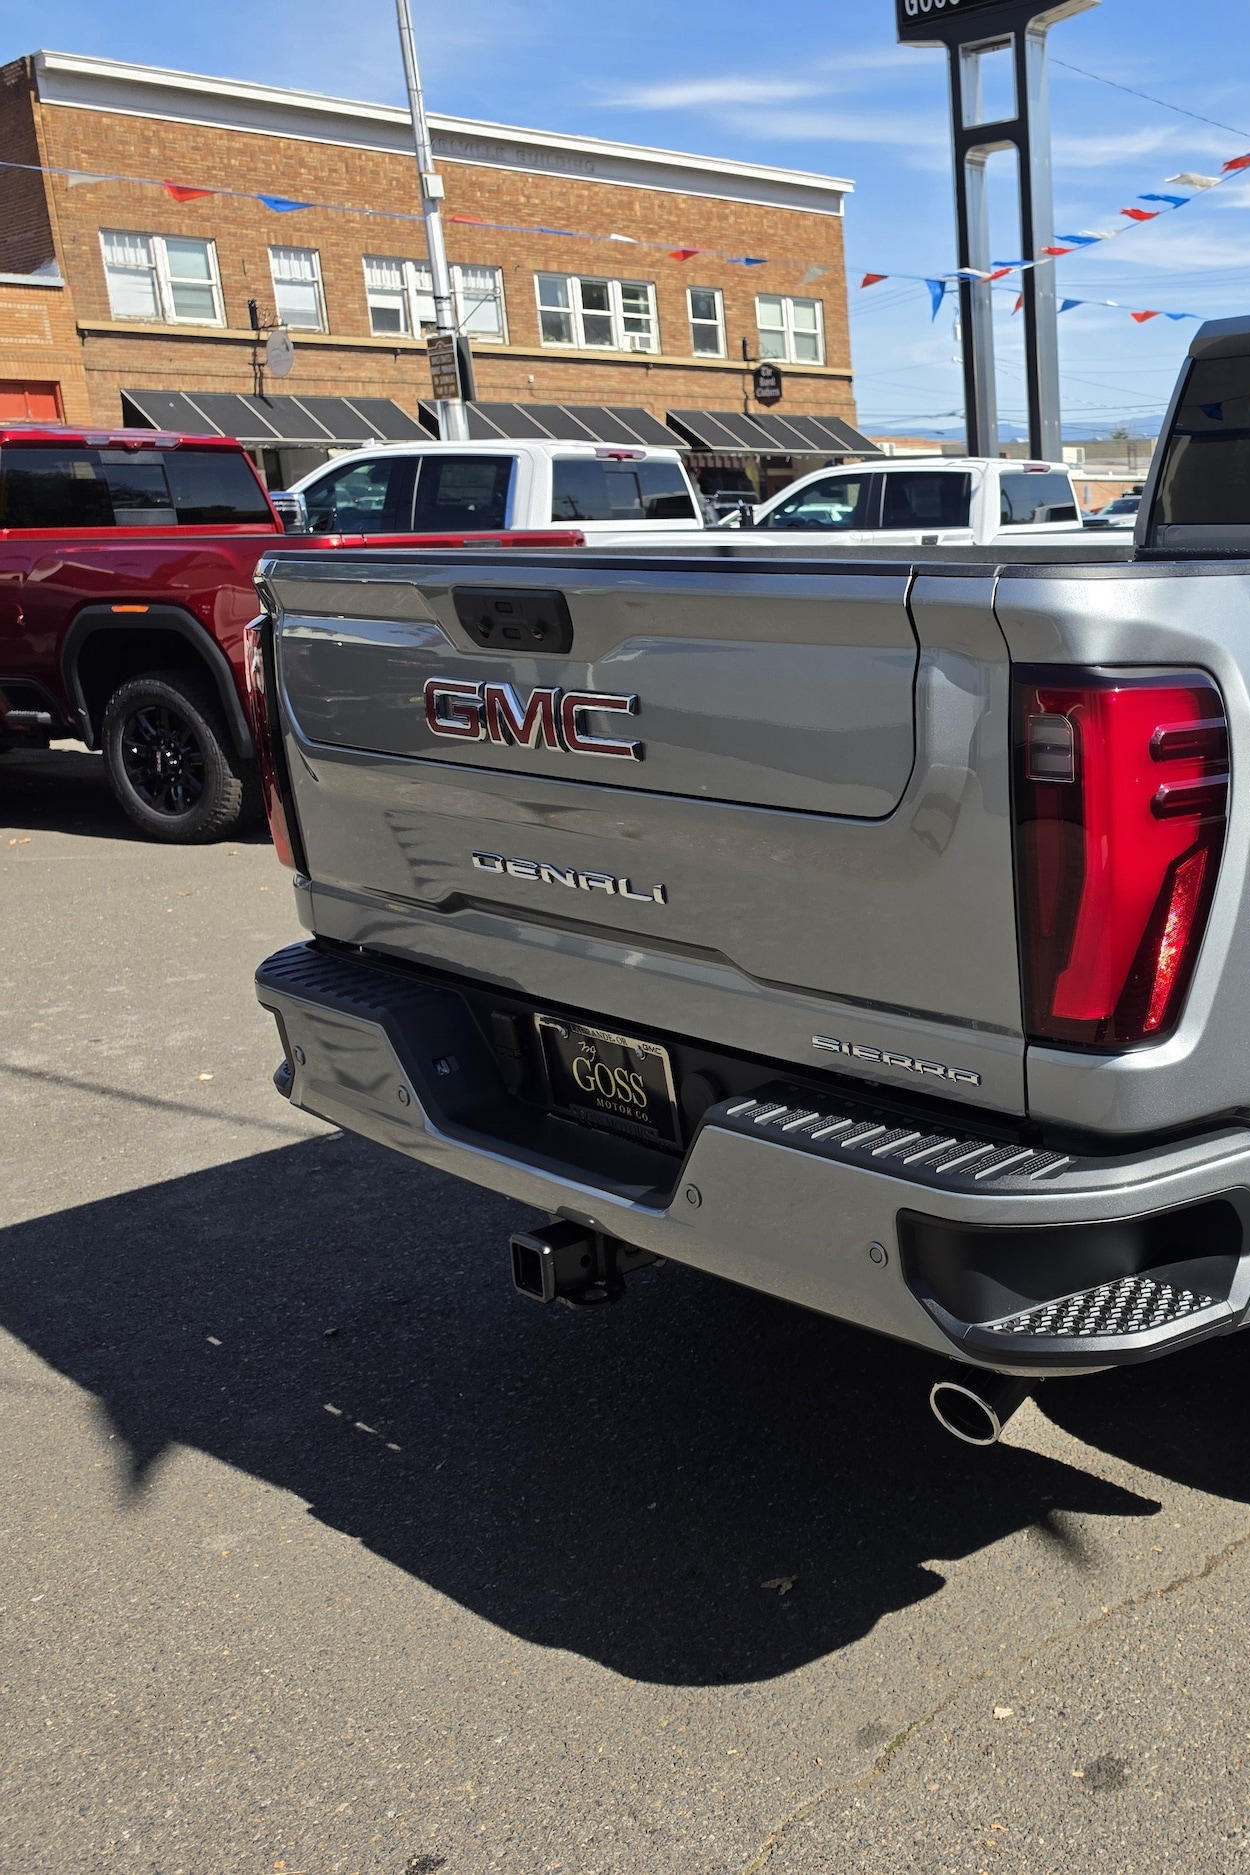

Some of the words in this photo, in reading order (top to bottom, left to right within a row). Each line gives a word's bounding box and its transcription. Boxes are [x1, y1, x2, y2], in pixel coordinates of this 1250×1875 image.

[423, 676, 643, 762] GMC
[472, 850, 667, 904] DENALI
[642, 1044, 661, 1054] GMC
[812, 1035, 982, 1087] SIERRA
[572, 1057, 647, 1108] GOSS
[596, 1098, 632, 1116] MOTOR
[635, 1110, 652, 1123] CO.
